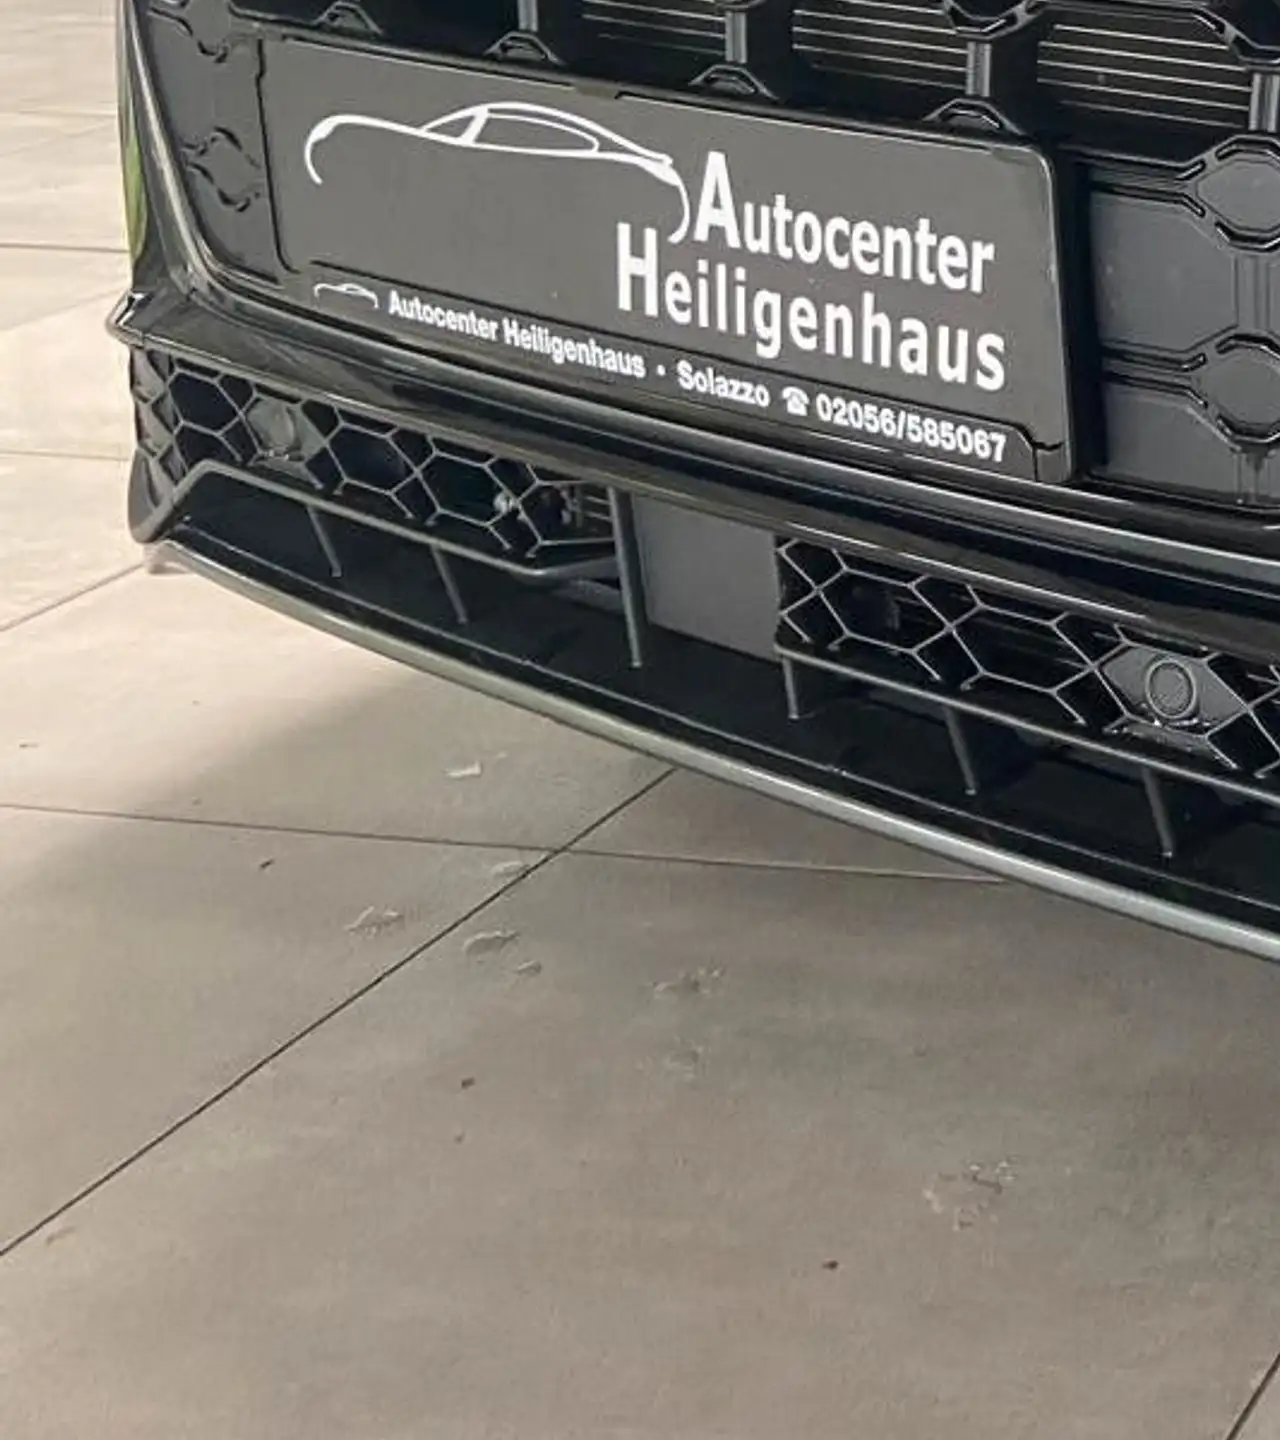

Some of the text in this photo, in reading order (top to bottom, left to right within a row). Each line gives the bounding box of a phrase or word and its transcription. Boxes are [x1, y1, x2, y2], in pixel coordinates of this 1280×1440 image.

[616, 221, 1007, 392] Heiligenhaus
[693, 150, 995, 296] Autocenter
[387, 288, 1007, 463] Autocenter Heiligenhaus Solazzo 02056/585067
